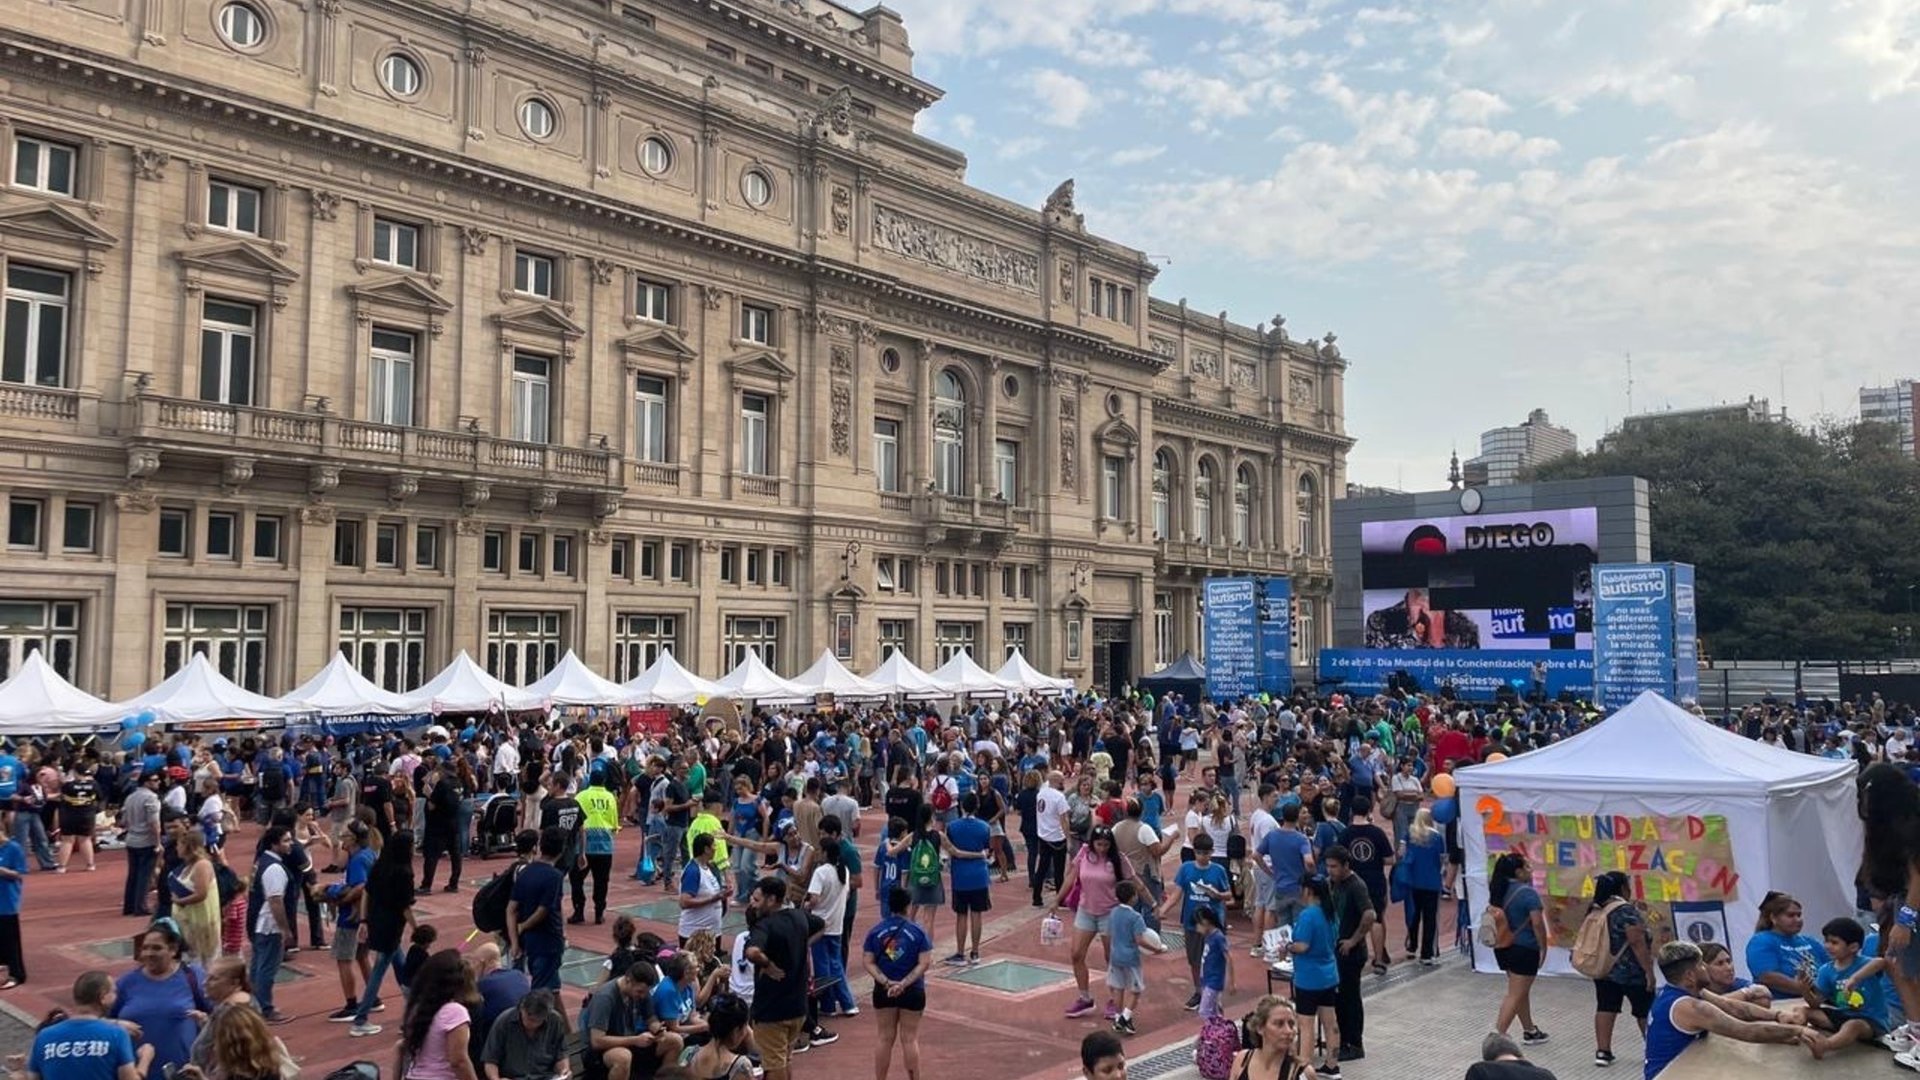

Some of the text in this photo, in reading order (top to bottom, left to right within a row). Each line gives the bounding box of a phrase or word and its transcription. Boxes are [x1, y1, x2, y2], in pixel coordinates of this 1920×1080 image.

[1466, 522, 1554, 549] DIEGO
[1601, 581, 1664, 595] autismo
[1210, 592, 1253, 604] autismo
[1331, 658, 1338, 667] 2
[1339, 658, 1350, 667] de
[1351, 658, 1372, 667] abril
[1394, 658, 1431, 667] Mundial
[1433, 658, 1445, 667] de
[1446, 658, 1455, 667] la
[1567, 660, 1577, 669] el
[1475, 794, 1513, 836] 2
